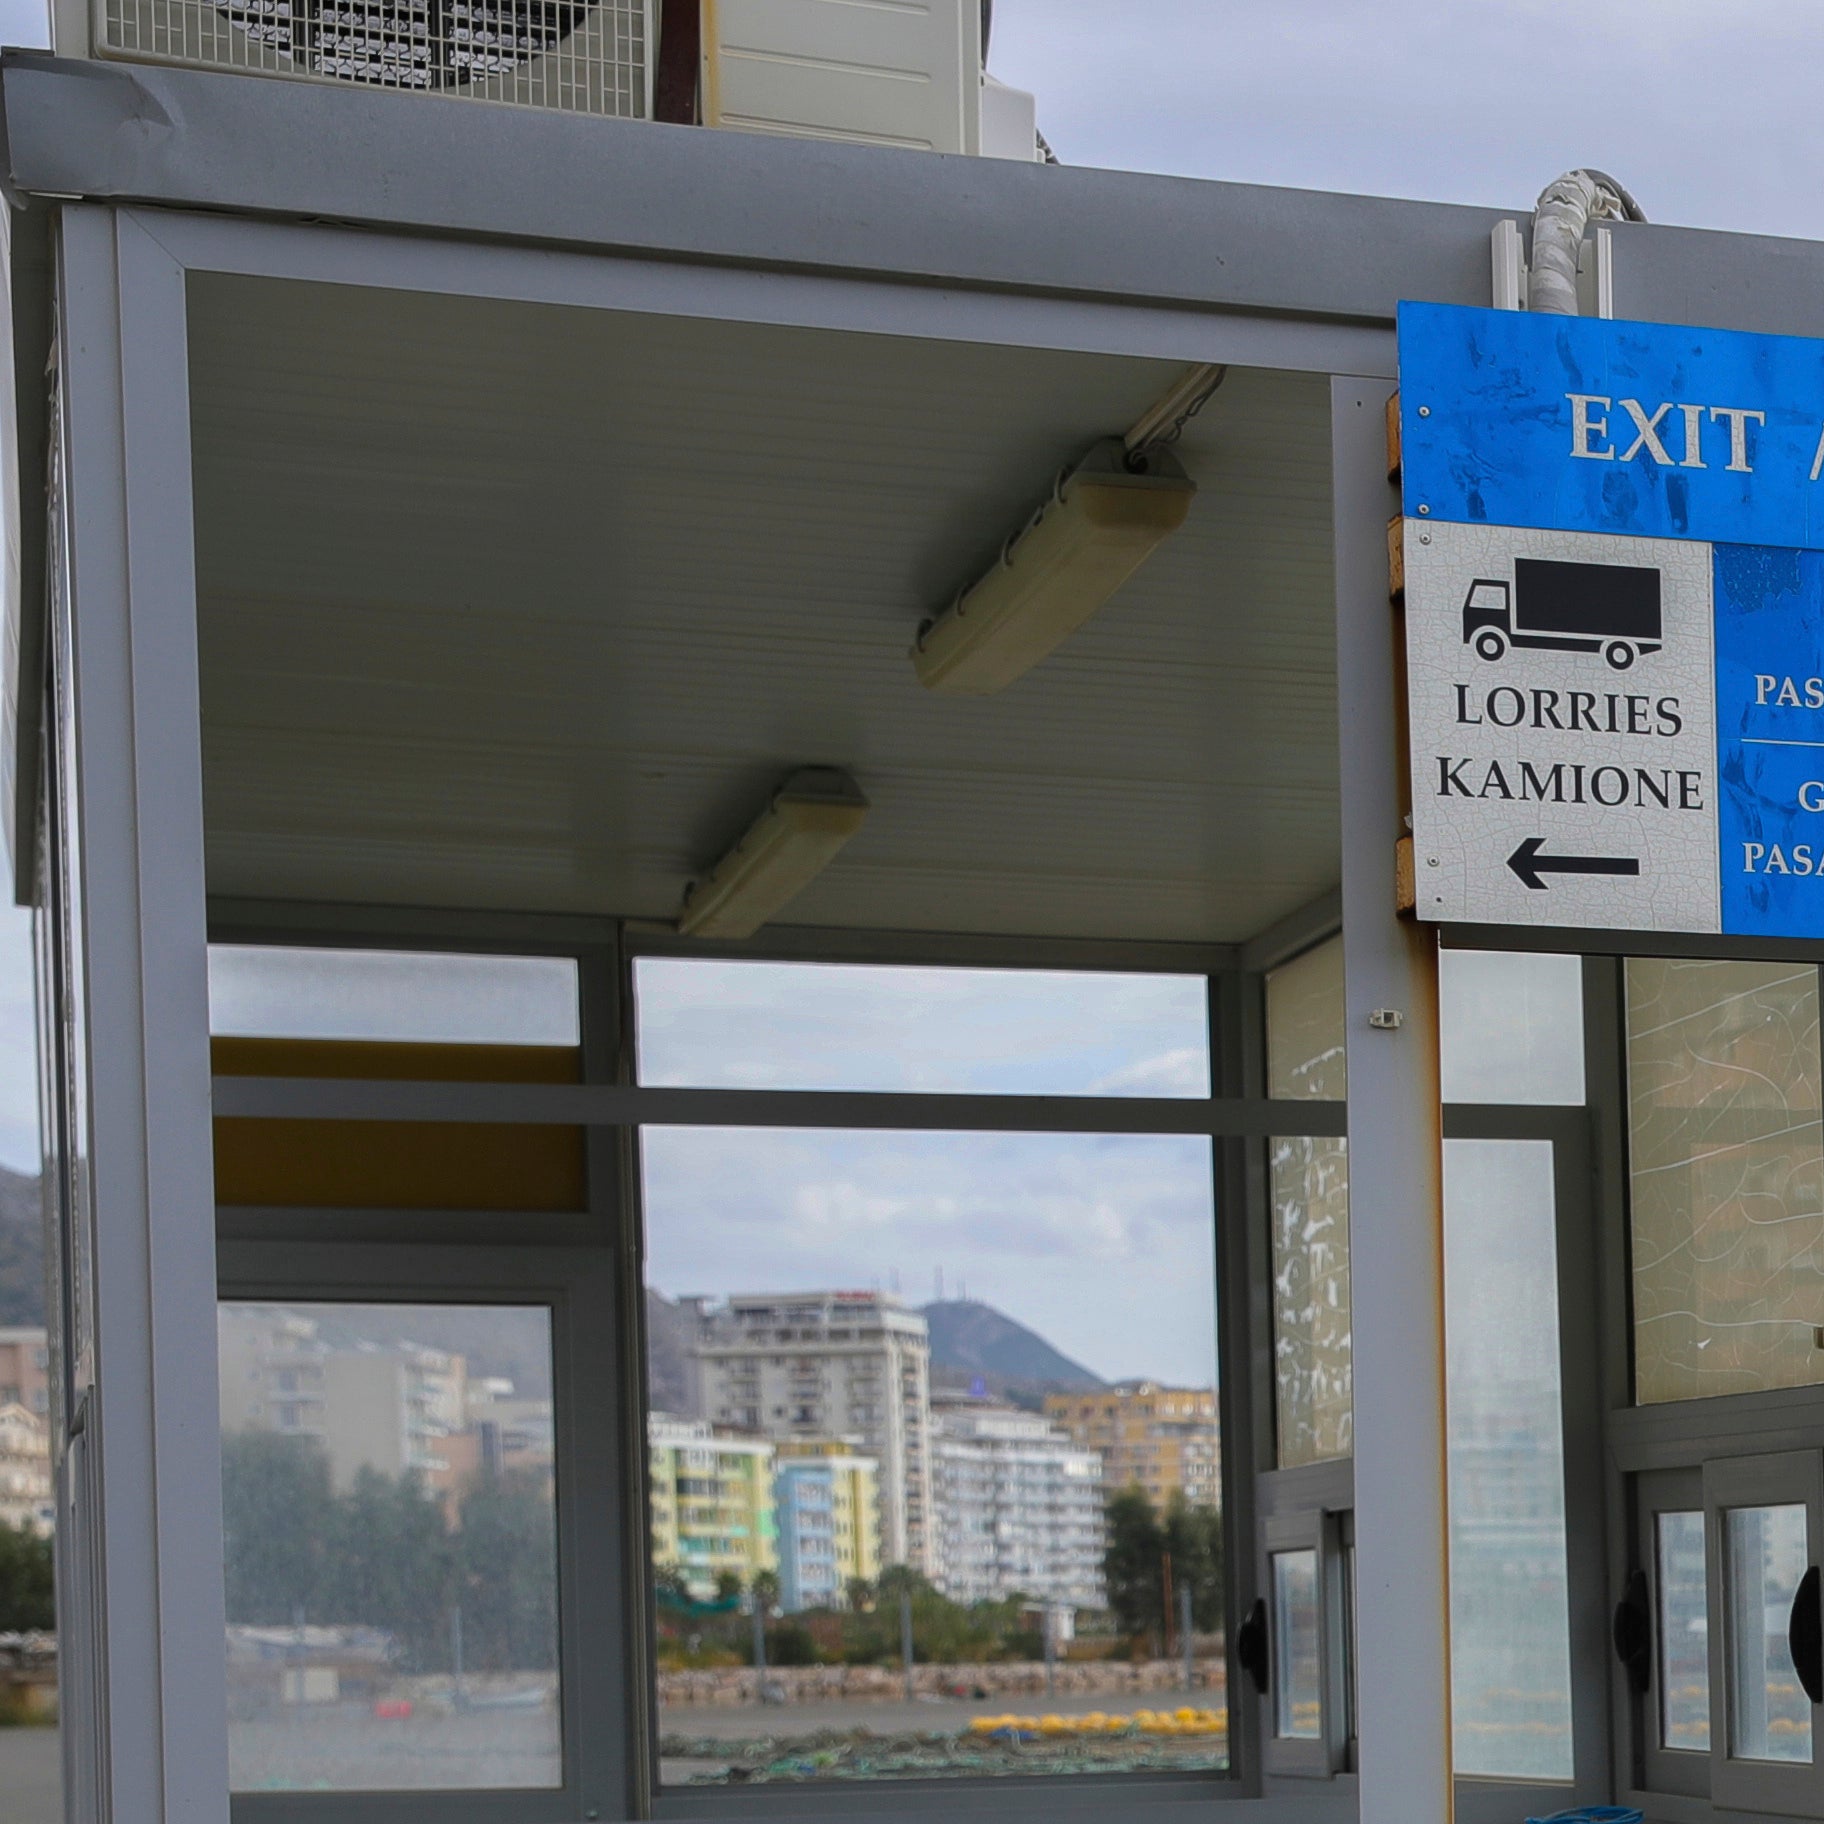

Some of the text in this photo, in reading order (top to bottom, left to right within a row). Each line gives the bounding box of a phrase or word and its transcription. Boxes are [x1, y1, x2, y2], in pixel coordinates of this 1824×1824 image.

[1565, 393, 1766, 474] EXIT
[1453, 683, 1684, 738] LORRIES
[1436, 757, 1704, 811] KAMIONE
